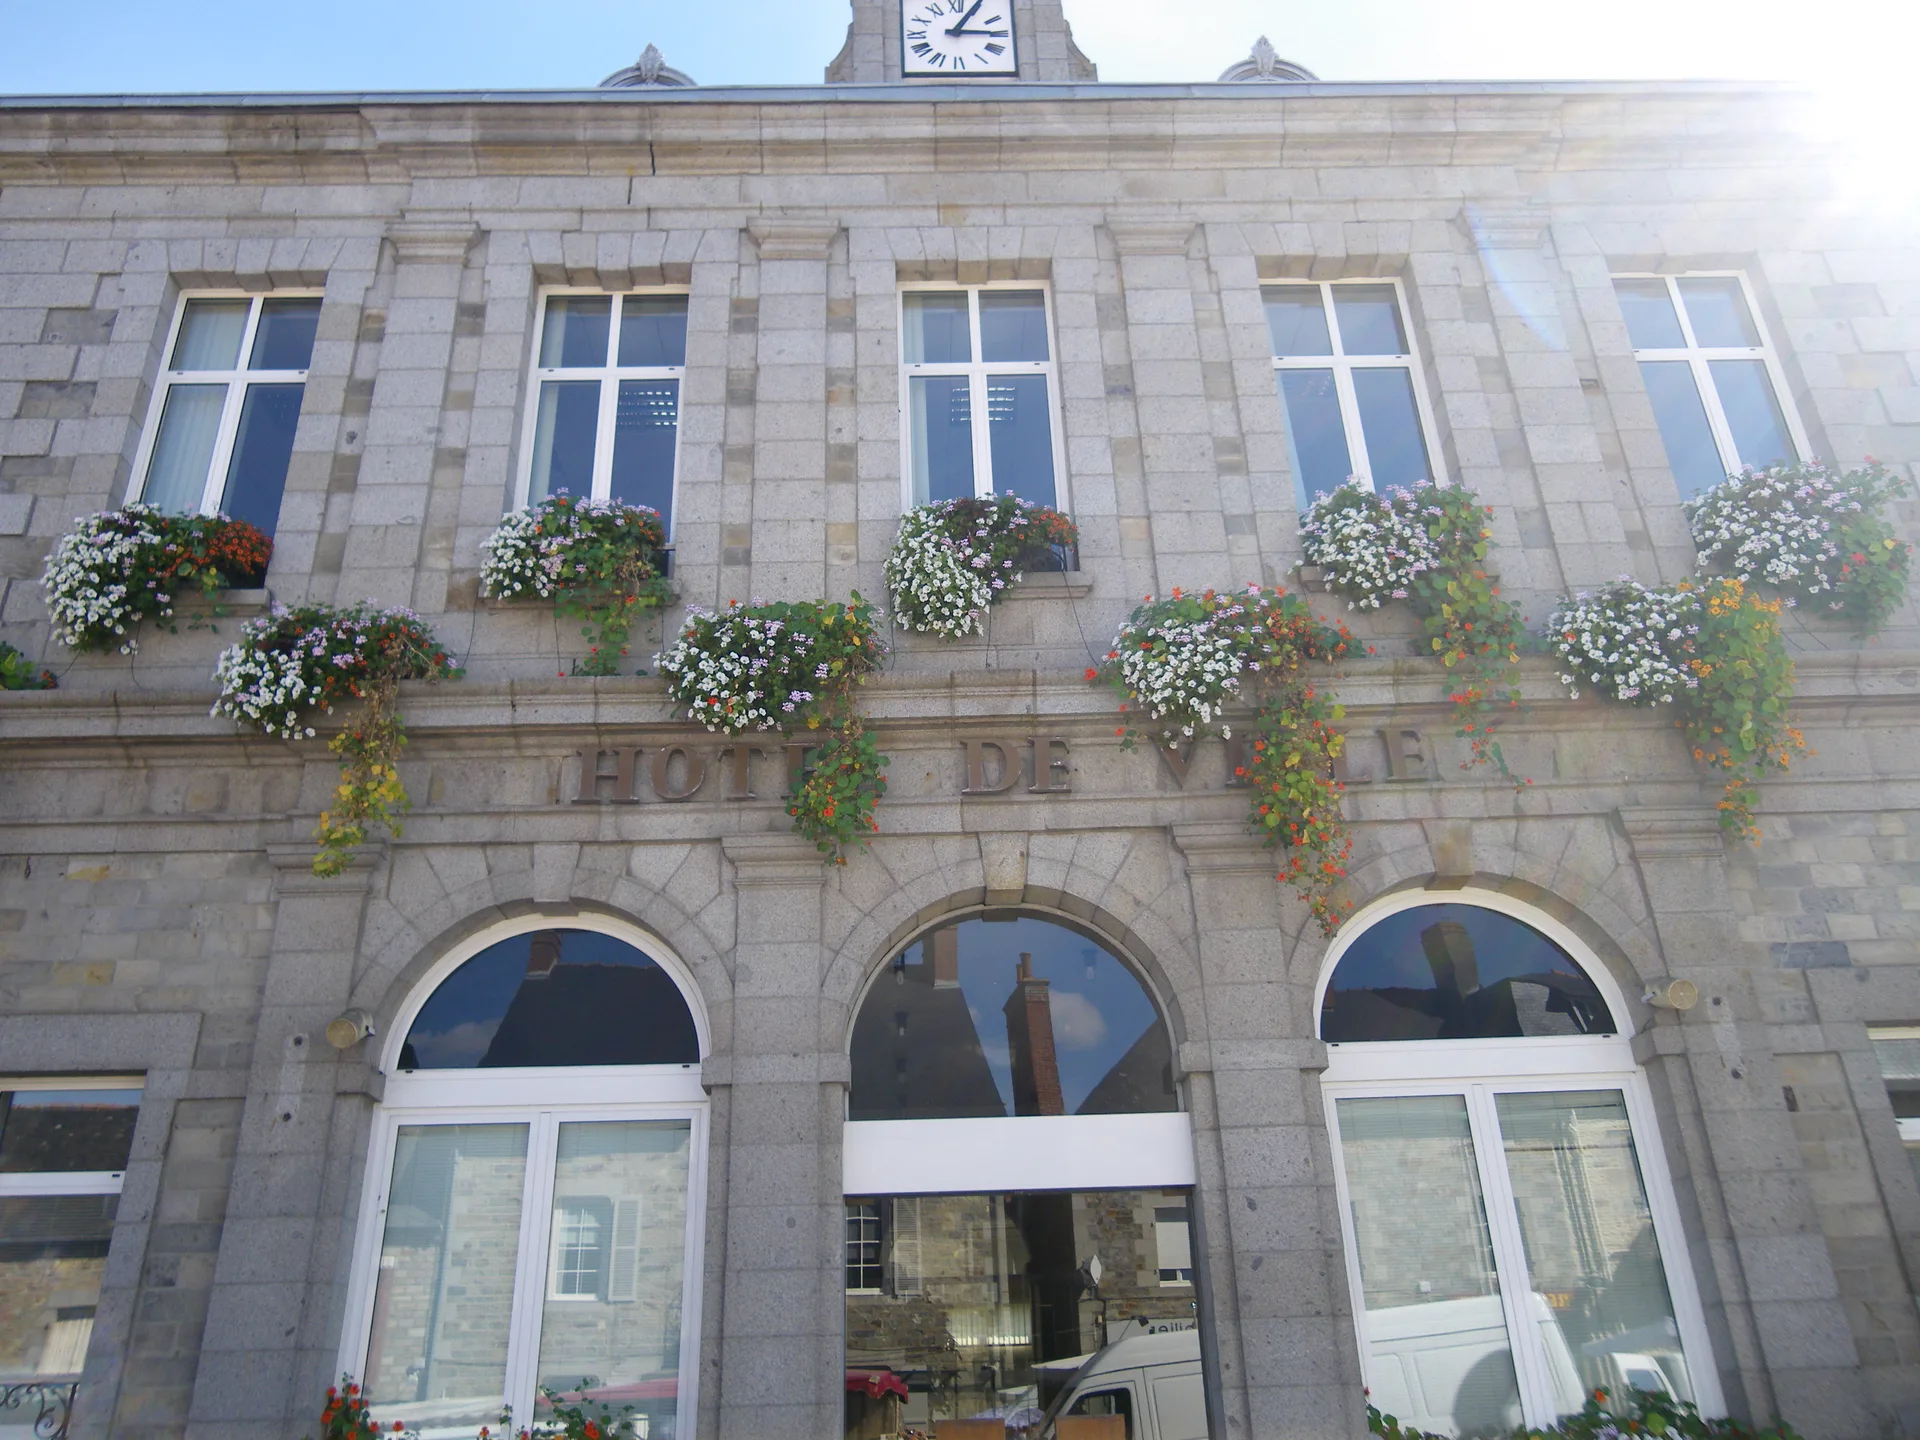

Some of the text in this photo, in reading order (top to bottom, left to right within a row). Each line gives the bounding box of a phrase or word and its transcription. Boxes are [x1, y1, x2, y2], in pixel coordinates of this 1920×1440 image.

[571, 728, 1429, 805] HOTE DE VILE
